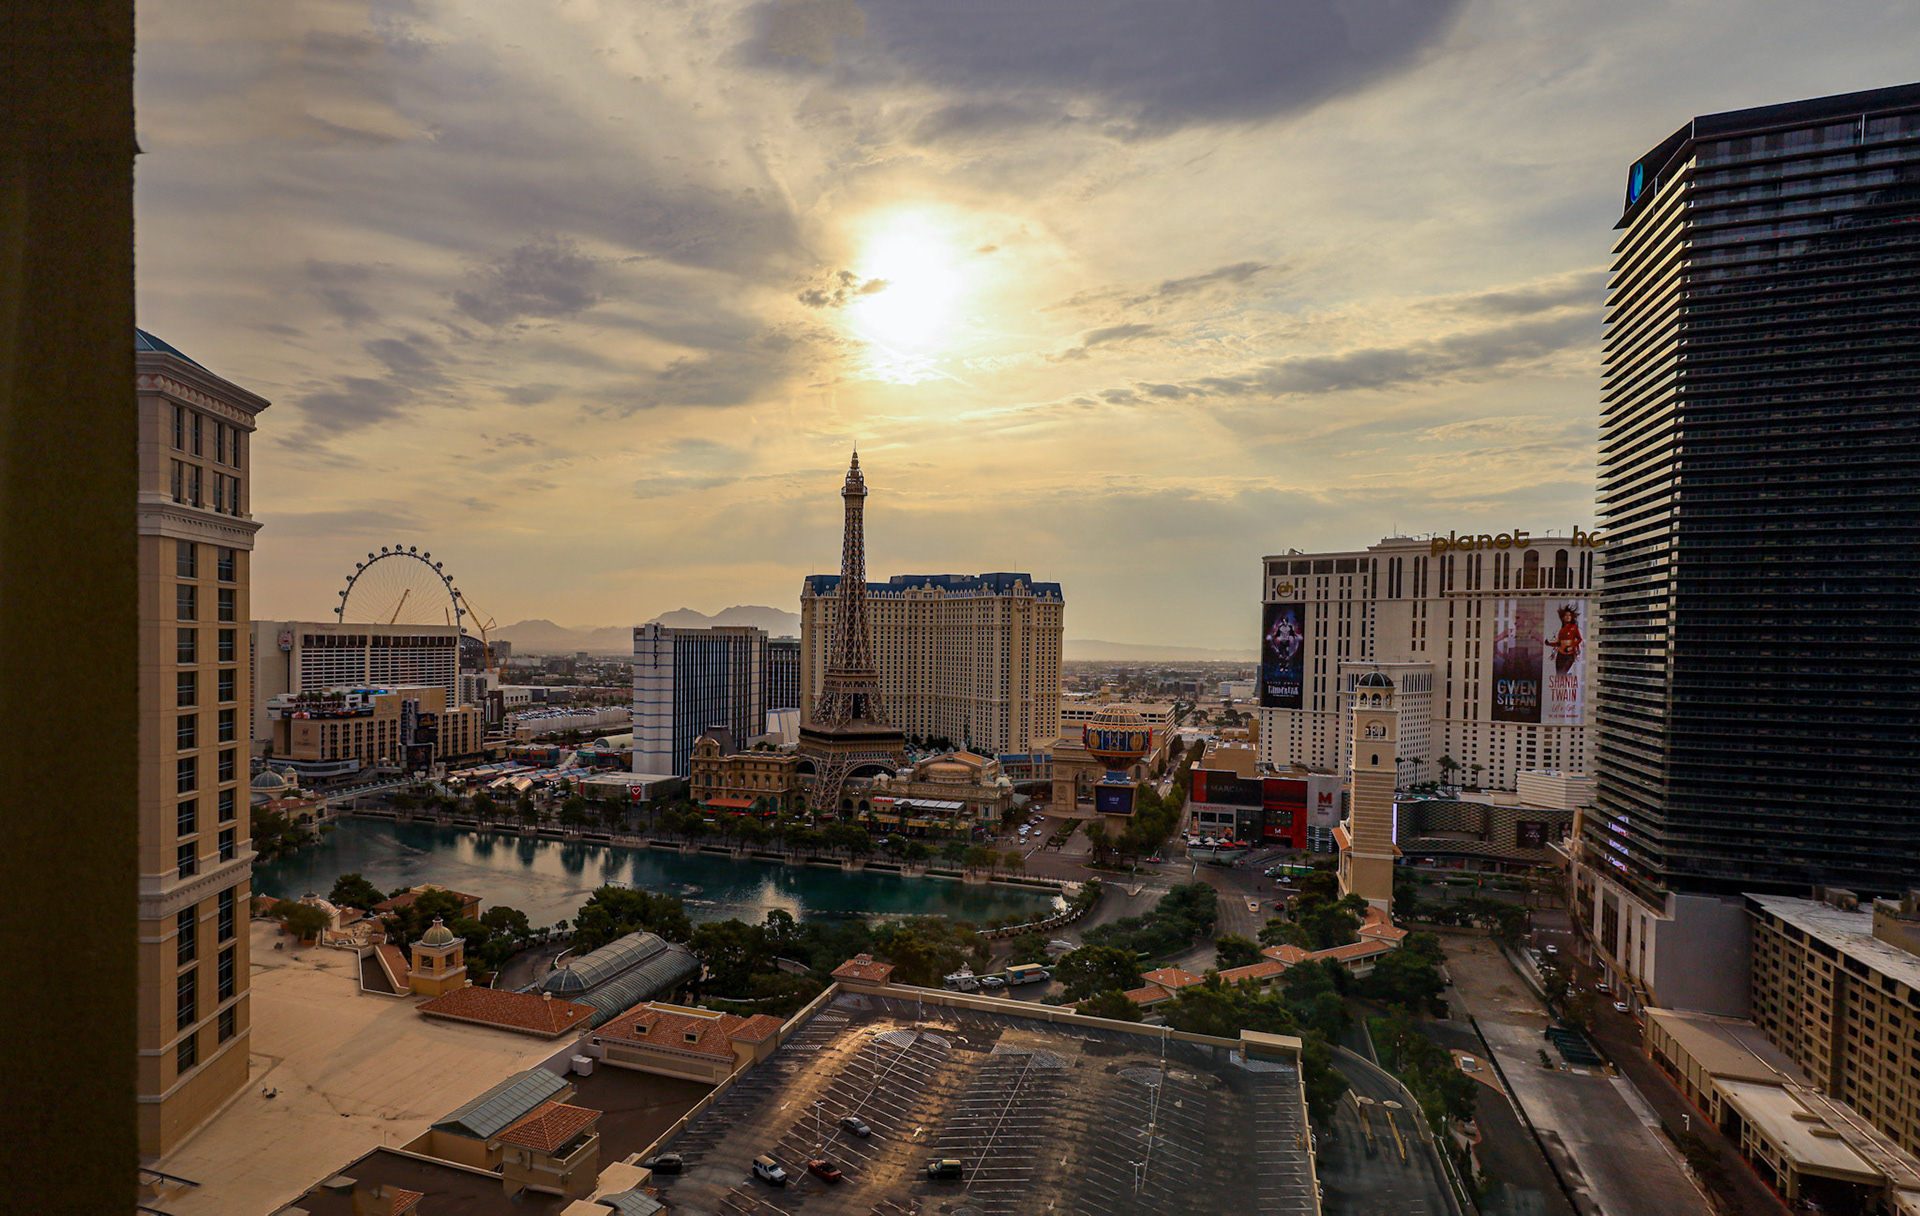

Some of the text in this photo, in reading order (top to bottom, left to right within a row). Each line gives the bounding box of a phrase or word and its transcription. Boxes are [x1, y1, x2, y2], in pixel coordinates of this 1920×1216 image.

[1431, 529, 1530, 557] planet
[1497, 680, 1537, 694] GWEN
[1549, 675, 1578, 688] SHANIA
[1497, 694, 1537, 706] STEFANI
[1551, 689, 1576, 702] TWAIN
